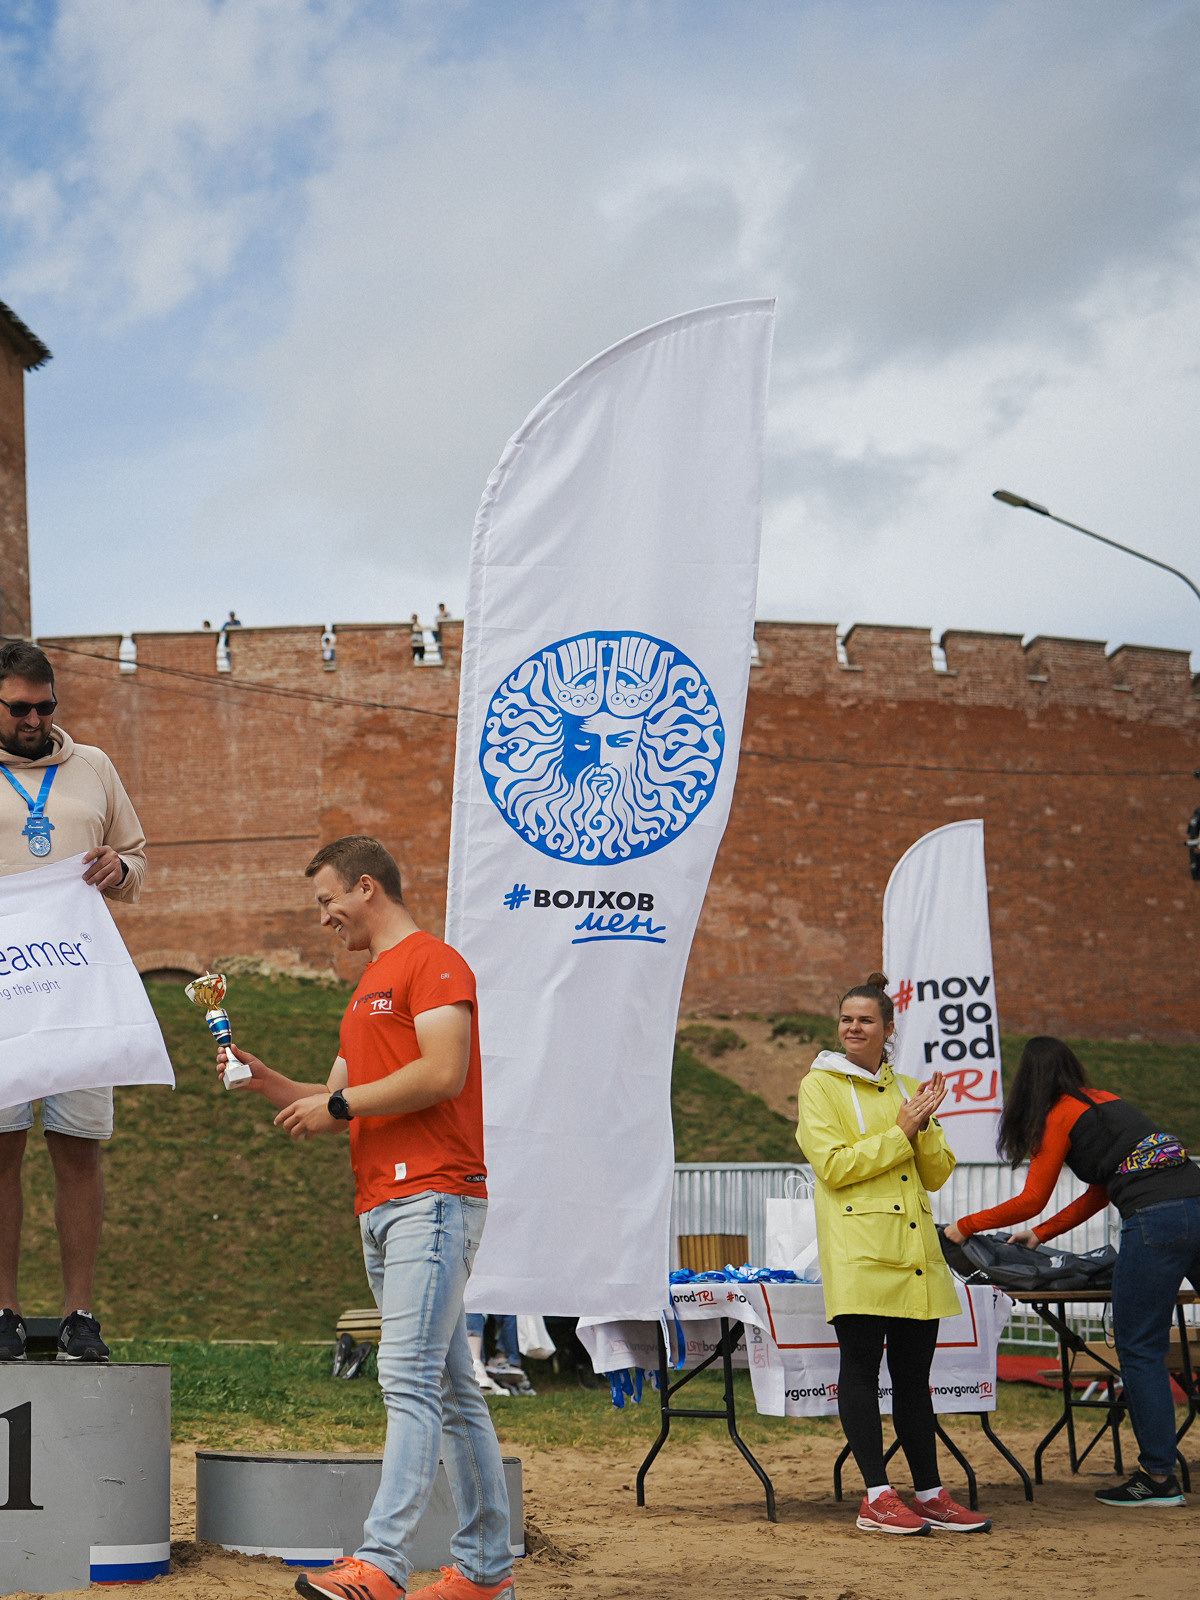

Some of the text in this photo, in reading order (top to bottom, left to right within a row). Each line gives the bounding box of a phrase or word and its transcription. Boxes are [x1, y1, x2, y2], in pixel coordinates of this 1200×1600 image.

[12, 983, 33, 997] the
[32, 979, 62, 994] light
[892, 976, 990, 1013] #nov
[370, 999, 393, 1011] TRI
[939, 1002, 992, 1035] go
[924, 1024, 995, 1064] rod
